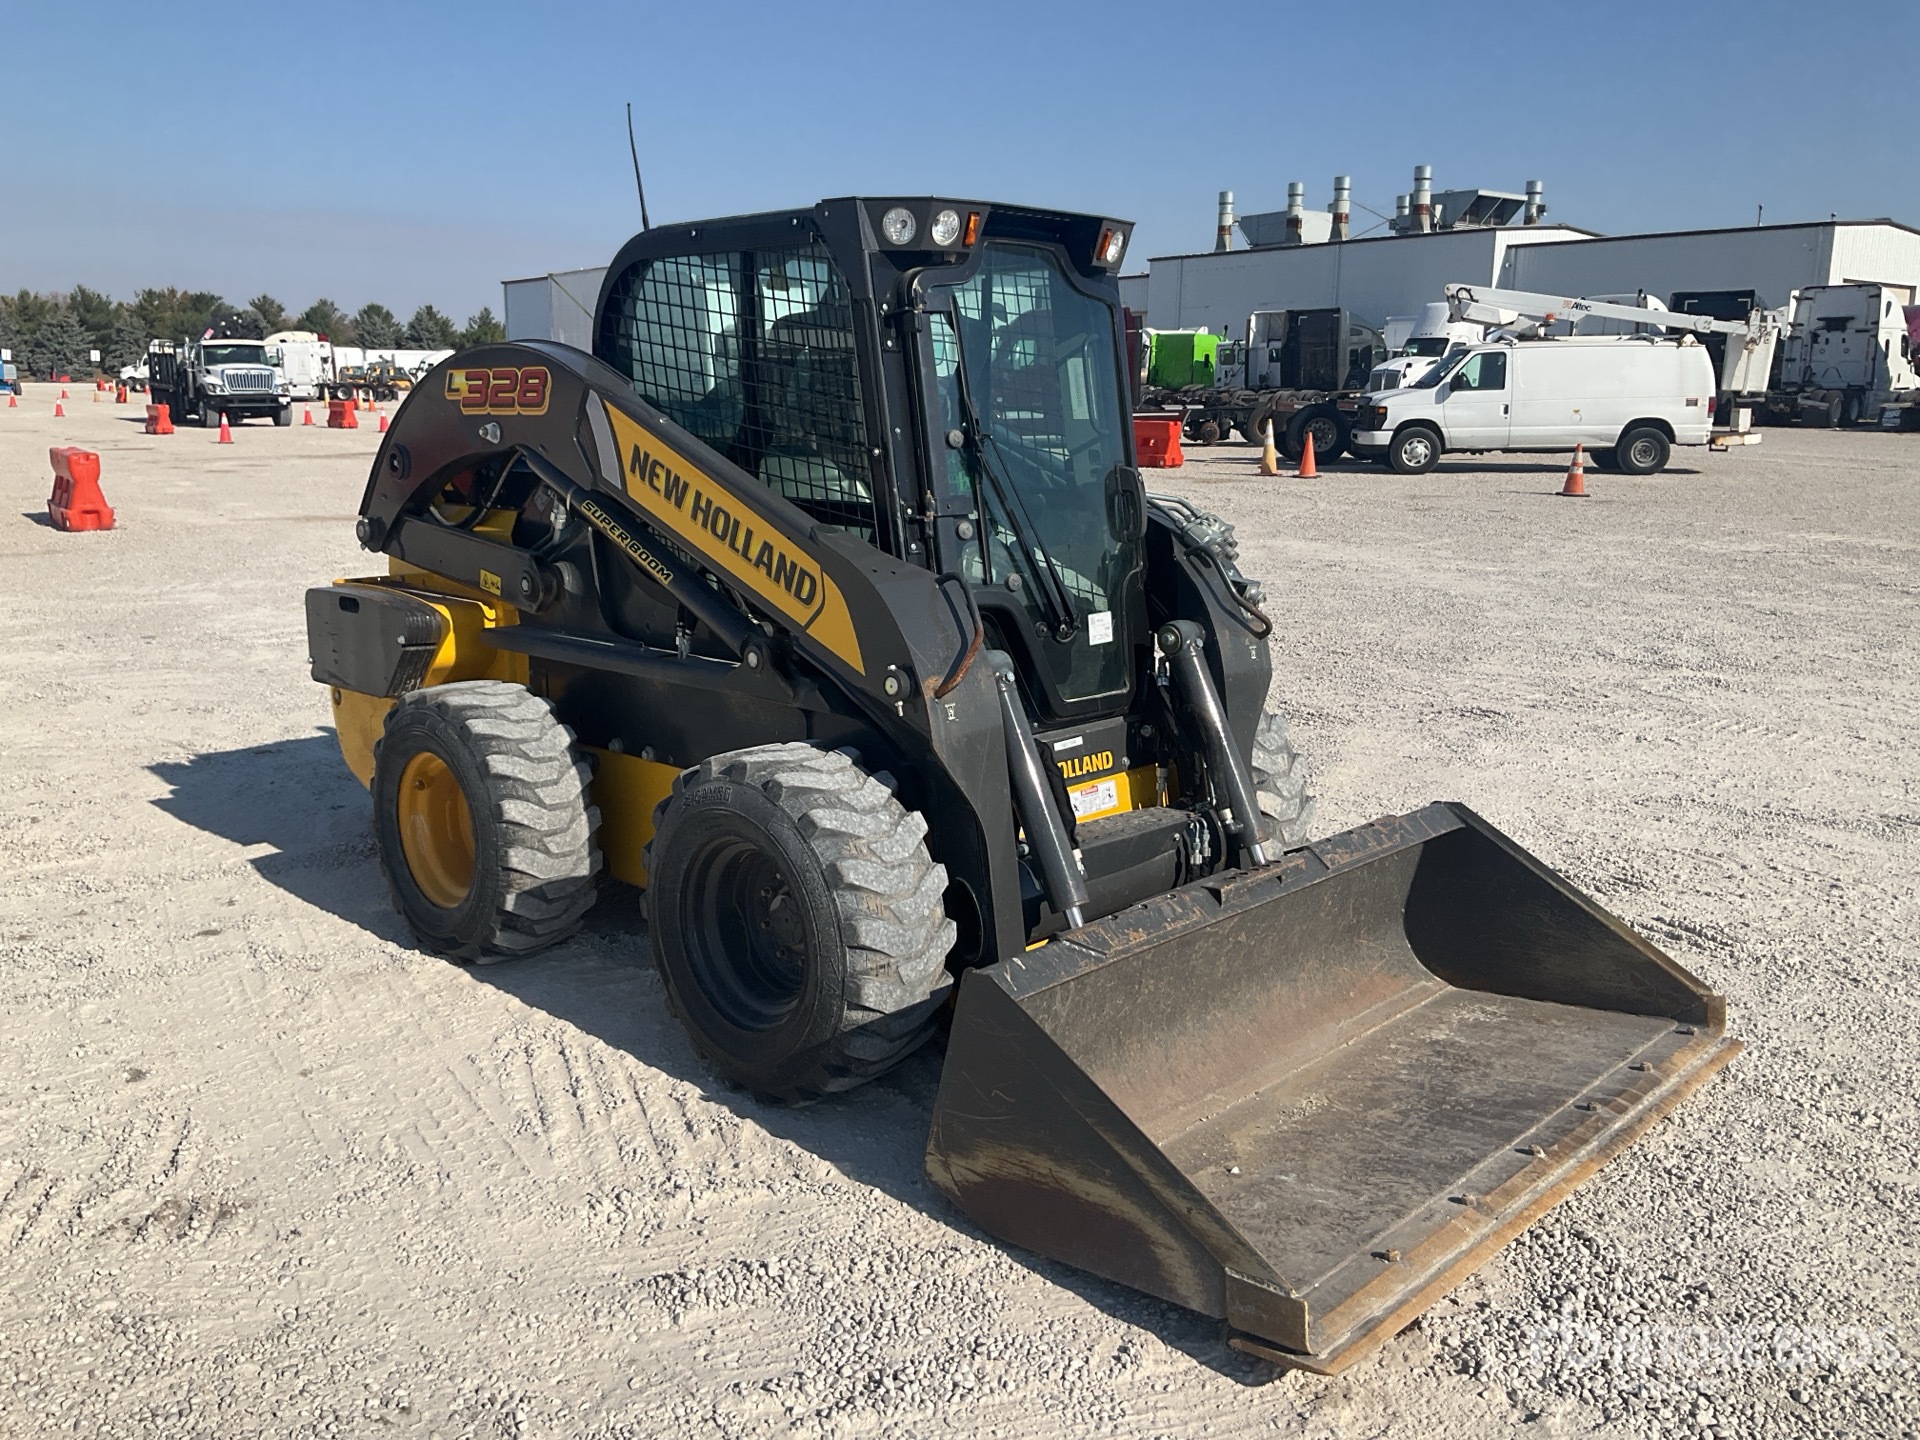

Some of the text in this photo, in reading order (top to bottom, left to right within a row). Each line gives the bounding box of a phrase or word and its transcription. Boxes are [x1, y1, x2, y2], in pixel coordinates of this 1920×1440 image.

[1571, 301, 1592, 312] Altec
[445, 367, 551, 414] L328
[582, 500, 673, 583] SUPER BOOM
[629, 442, 818, 607] NEW HOLLAND
[1057, 750, 1113, 779] OLLAND
